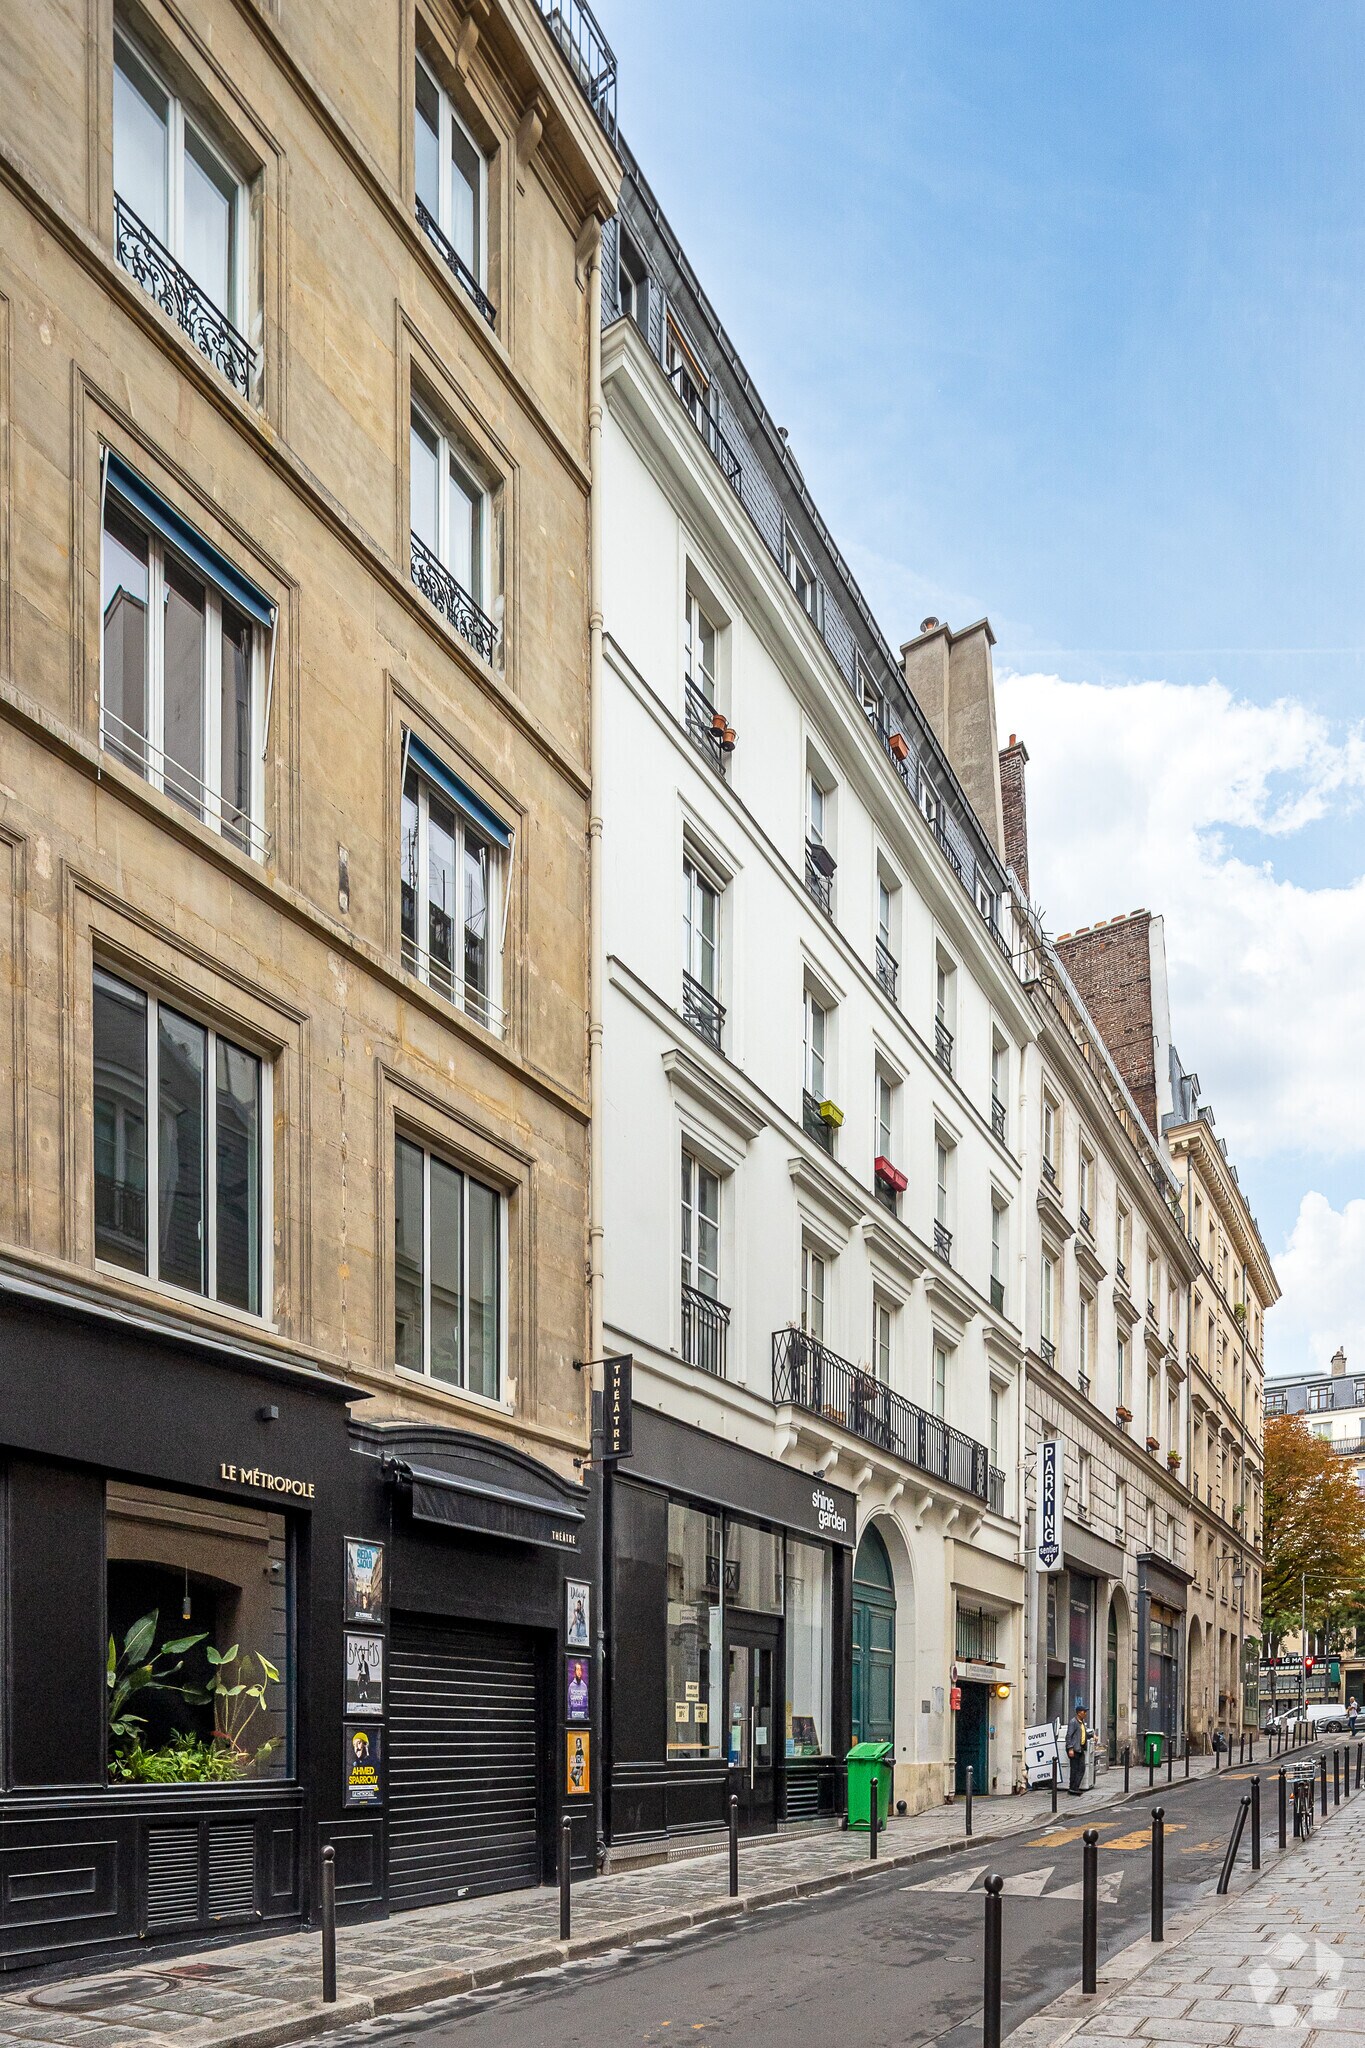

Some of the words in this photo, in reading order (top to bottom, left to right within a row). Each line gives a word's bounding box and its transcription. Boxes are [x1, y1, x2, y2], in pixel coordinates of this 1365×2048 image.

[613, 1364, 621, 1451] THÉÂTRE
[220, 1463, 237, 1481] LE
[239, 1467, 315, 1498] MÉTROPOLE
[1044, 1447, 1054, 1543] PARKING
[812, 1489, 835, 1513] shine
[818, 1509, 847, 1533] garden
[1039, 1545, 1059, 1555] sentier
[1044, 1554, 1054, 1563] 41
[1027, 1732, 1047, 1741] OUVERT
[1036, 1750, 1045, 1763] P
[352, 1766, 375, 1776] AHMED
[1036, 1772, 1051, 1780] OPEN
[348, 1775, 379, 1785] SPARROW
